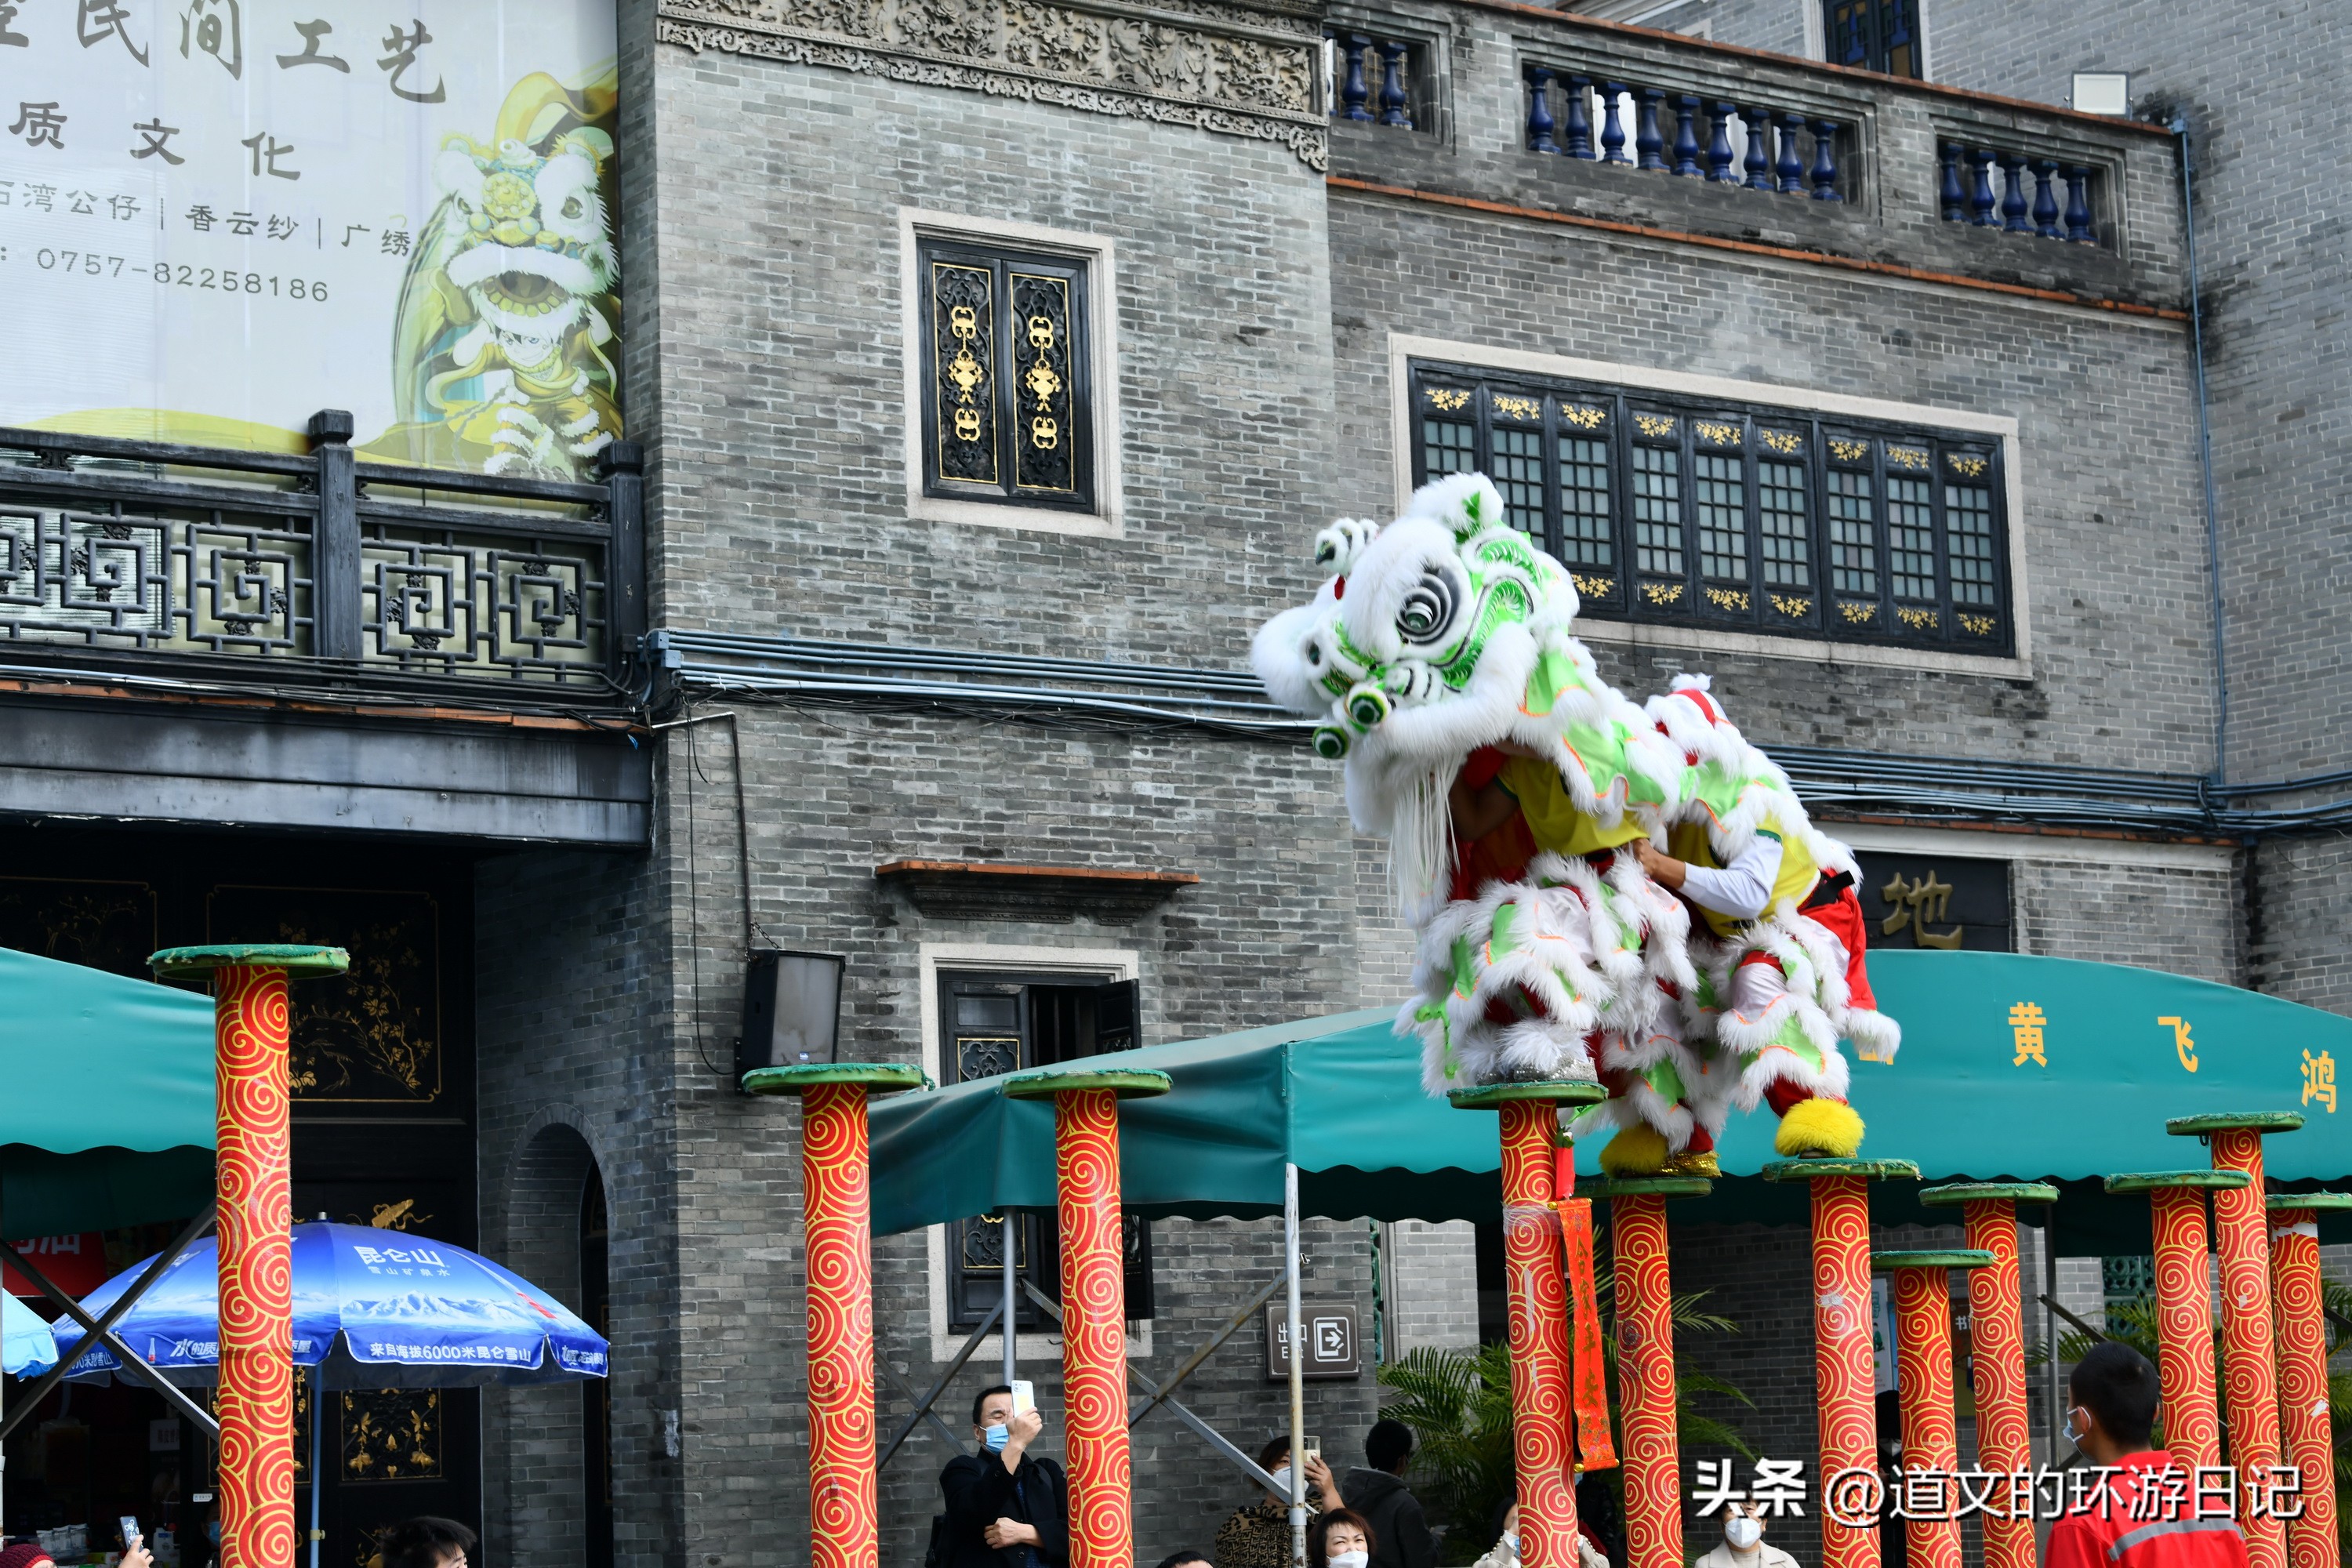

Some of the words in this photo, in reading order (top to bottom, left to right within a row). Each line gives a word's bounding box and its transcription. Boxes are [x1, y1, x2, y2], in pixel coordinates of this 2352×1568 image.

[9, 102, 301, 181] 质文化
[185, 205, 299, 241] 香云纱
[341, 224, 411, 256] 广绣
[37, 248, 328, 302] 0757-82258186
[1882, 869, 1962, 949] 地
[1859, 1001, 2337, 1114] 黄飞鸿
[353, 1245, 445, 1268] 昆仑山
[370, 1341, 532, 1363] 来自海拔6000米昆仑雪山
